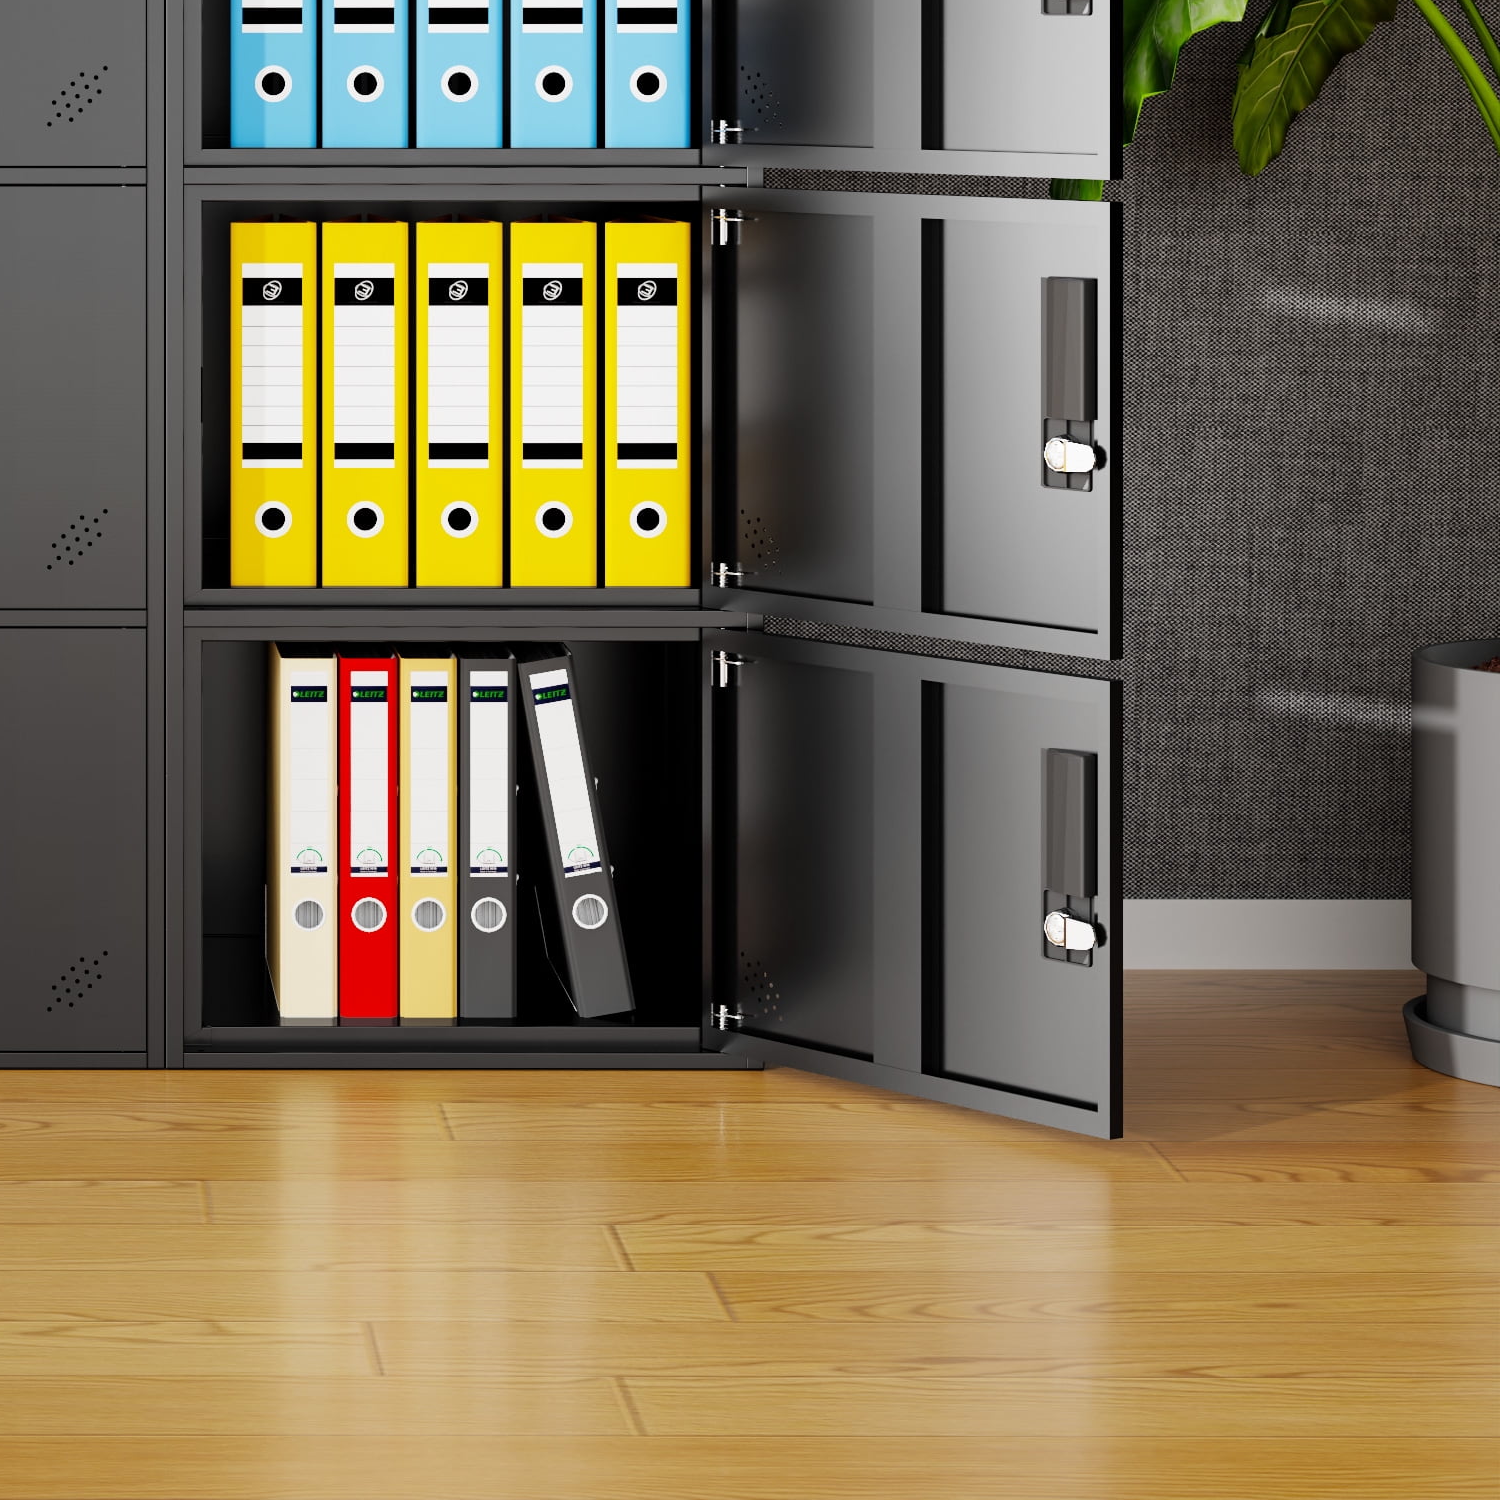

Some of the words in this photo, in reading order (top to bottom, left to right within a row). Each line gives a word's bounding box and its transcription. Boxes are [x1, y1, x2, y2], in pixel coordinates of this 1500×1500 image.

[300, 690, 325, 698] LEITZ
[360, 690, 385, 698] LEITZ
[419, 690, 444, 698] LEITZ
[479, 690, 504, 698] LEITZ
[542, 688, 567, 700] LEITZ
